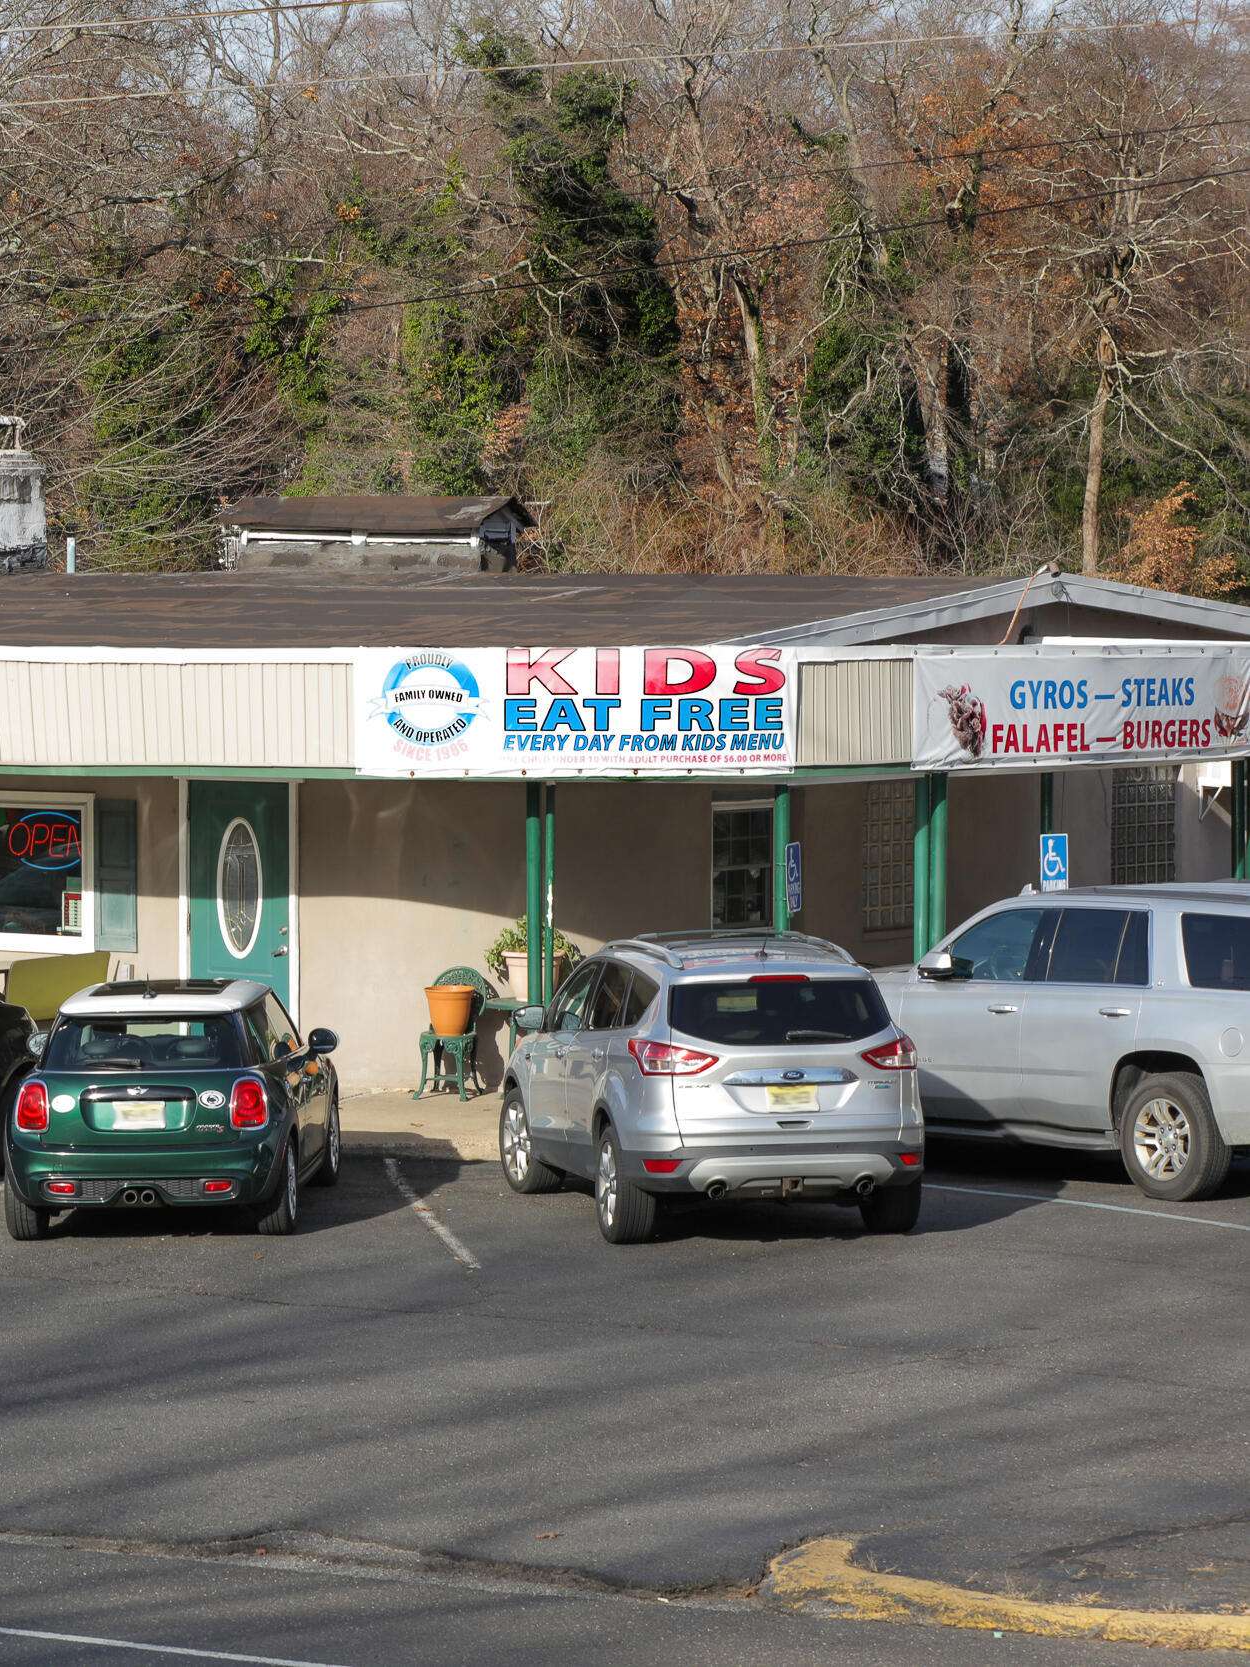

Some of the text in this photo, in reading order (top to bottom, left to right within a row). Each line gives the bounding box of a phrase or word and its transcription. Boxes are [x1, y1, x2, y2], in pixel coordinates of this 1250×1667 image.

[405, 652, 453, 669] PROUDLY
[506, 648, 785, 695] KIDS
[394, 689, 463, 702] FAMILY OWNED
[1009, 679, 1088, 710] GYROS
[1121, 677, 1195, 708] STEAKS
[504, 698, 783, 731] EAT FREE
[393, 718, 467, 742] AND OPERATED
[503, 733, 785, 751] EVERY DAY FROM KIDS MENU
[992, 723, 1090, 753] FALAFEL
[1122, 719, 1211, 750] BURGERS
[393, 739, 432, 761] SINCE
[602, 755, 625, 763] WITH
[628, 755, 659, 764] ADULT
[661, 755, 708, 763] PURCHASE
[710, 755, 721, 763] OF
[750, 754, 761, 762] OR
[763, 753, 787, 762] MORE
[8, 822, 82, 858] OPEN
